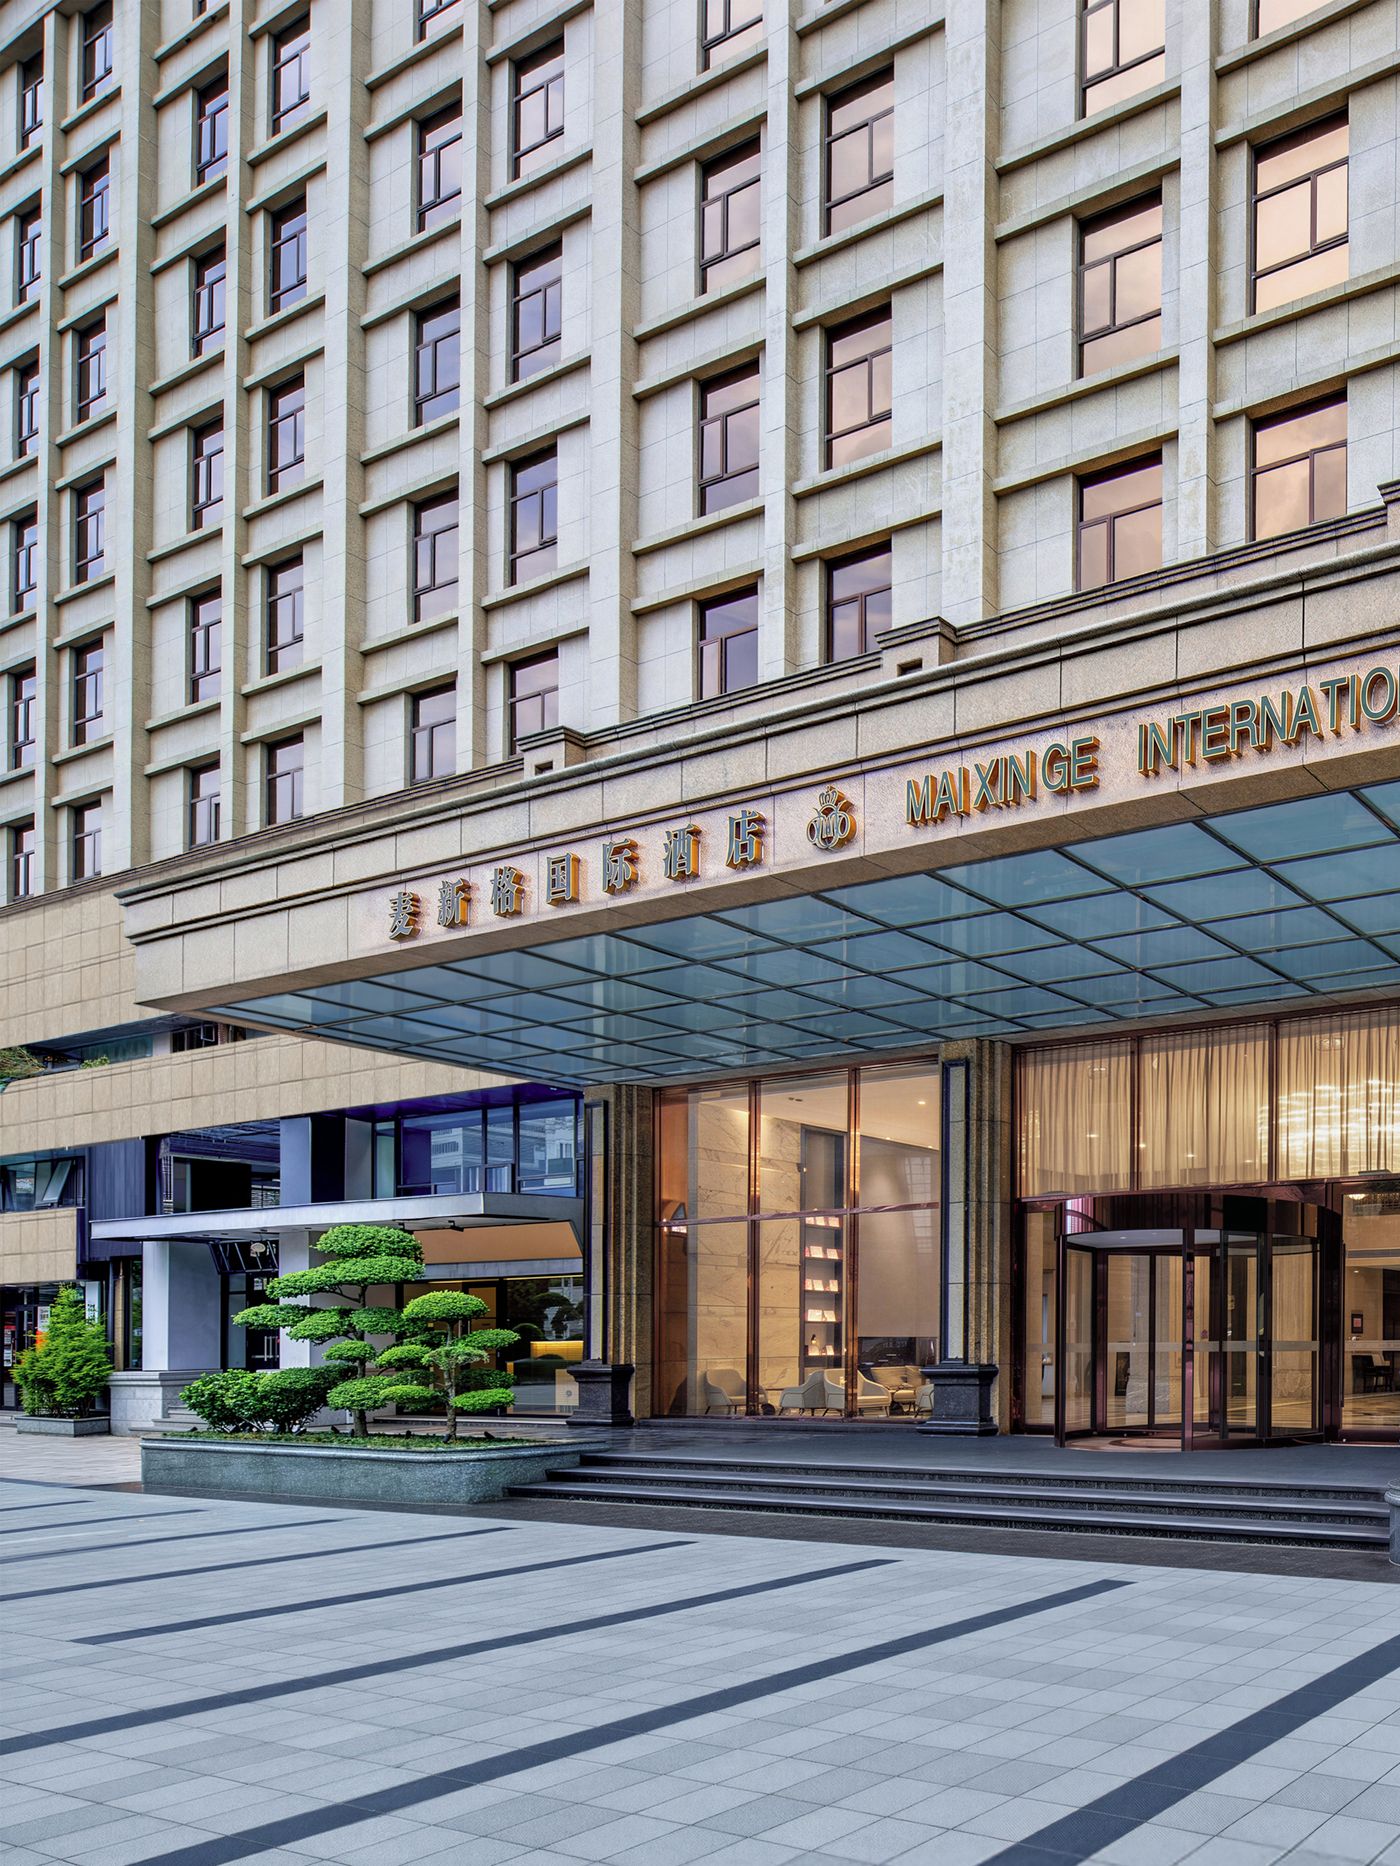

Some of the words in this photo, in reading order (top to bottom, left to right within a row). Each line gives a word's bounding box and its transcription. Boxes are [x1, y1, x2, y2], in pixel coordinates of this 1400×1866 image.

[389, 809, 766, 941] 麦新格国际酒店
